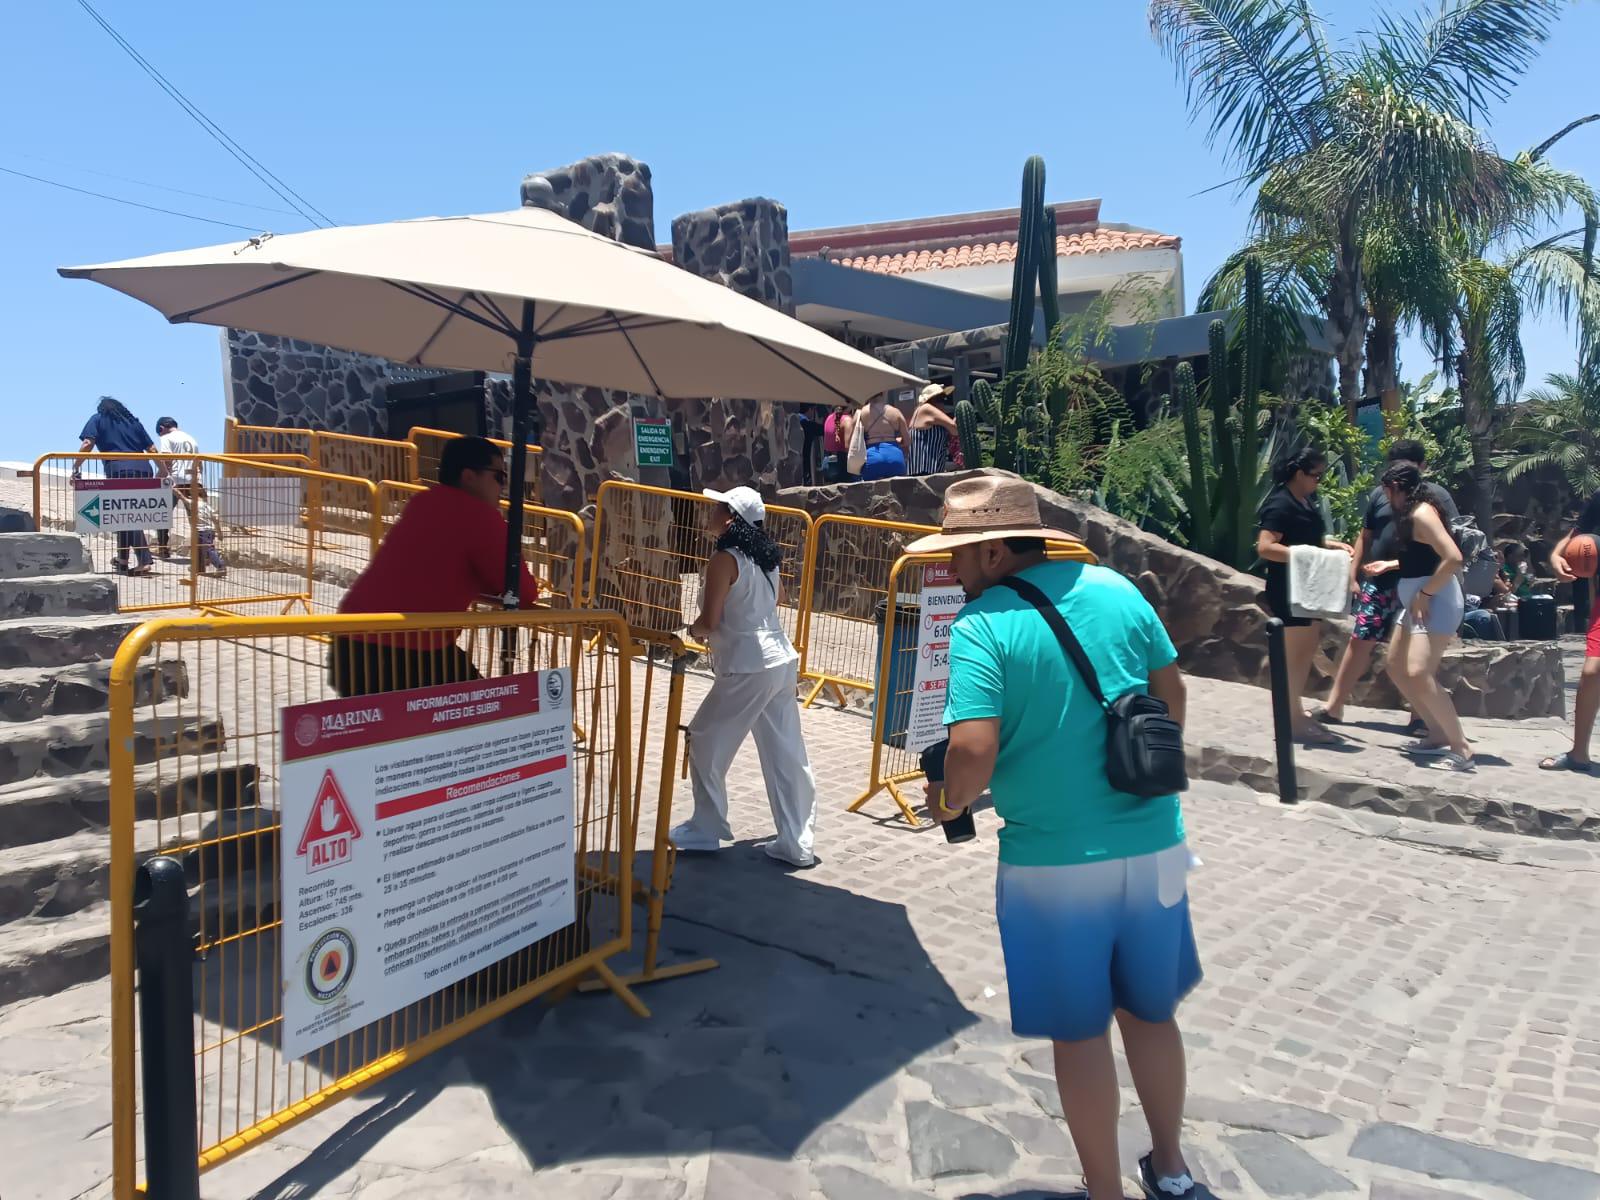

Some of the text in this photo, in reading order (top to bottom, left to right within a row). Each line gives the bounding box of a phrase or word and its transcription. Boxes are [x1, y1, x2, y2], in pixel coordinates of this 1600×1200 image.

[103, 498, 168, 510] ENTRADA
[103, 512, 168, 524] ENTRANCE
[407, 684, 519, 711] INFORMACION IMPORTANTE
[321, 708, 382, 730] MARINA
[432, 701, 500, 723] ANTES DE SUBIR
[375, 765, 388, 773] Los
[390, 757, 423, 769] visitantes
[386, 771, 412, 780] manera
[413, 761, 453, 776] responsable
[423, 770, 457, 784] incluyendo
[446, 772, 521, 799] Recomendaciones
[383, 825, 404, 836] Llevar
[406, 820, 422, 830] agua
[424, 816, 437, 826] para
[419, 827, 436, 839] gorra
[312, 838, 347, 867] ALTO
[389, 845, 414, 857] realizar
[416, 834, 449, 849] descansos
[384, 874, 391, 882] El
[392, 867, 415, 879] tiempo
[417, 857, 446, 871] estimado
[456, 848, 470, 858] subir
[299, 879, 335, 896] Recorrido
[384, 884, 392, 894] 25
[400, 879, 408, 888] 35
[299, 894, 324, 908] Altura:
[327, 888, 338, 898] 157
[384, 900, 416, 917] Prevenga
[427, 890, 444, 903] golpe
[299, 903, 333, 919] Ascenso:
[299, 912, 338, 931] Escalones:
[384, 916, 406, 929] riesgo
[384, 938, 406, 953] Queda
[408, 925, 438, 944] prohibida
[447, 912, 469, 927] entrada
[424, 969, 439, 979] Todo
[440, 962, 452, 972] con
[453, 957, 458, 966] el
